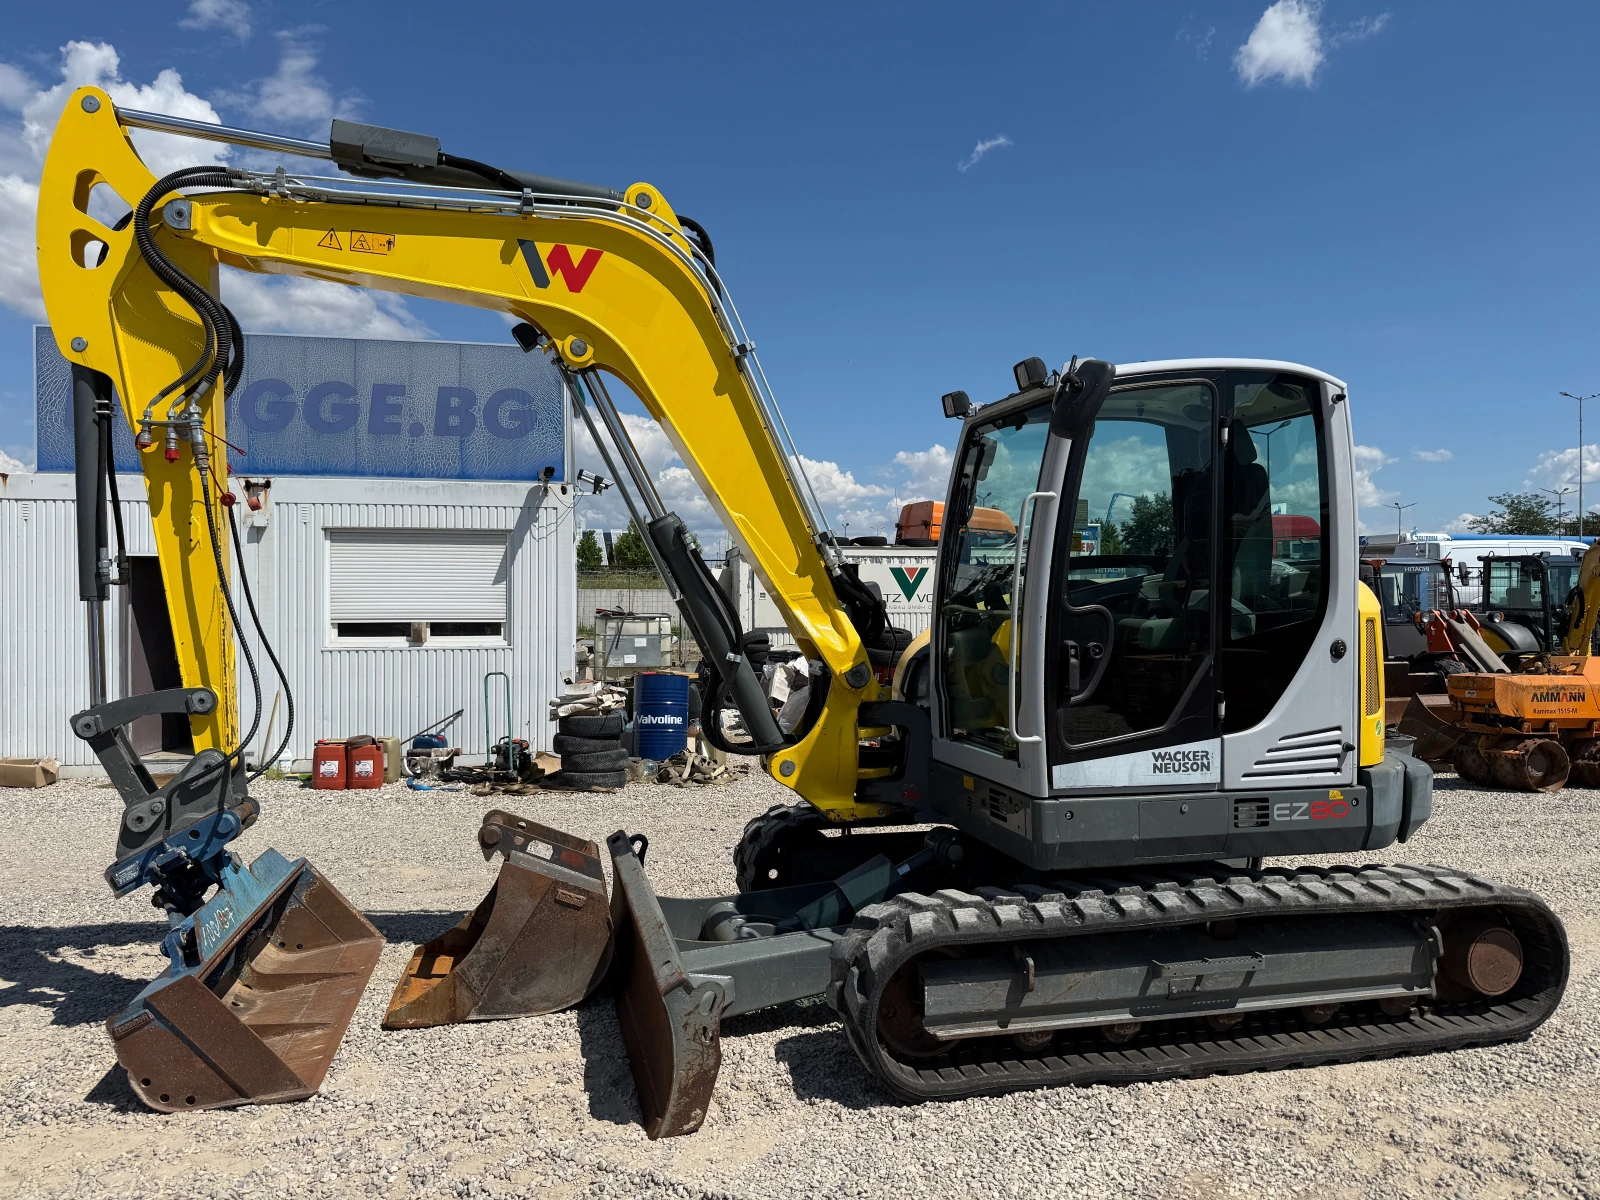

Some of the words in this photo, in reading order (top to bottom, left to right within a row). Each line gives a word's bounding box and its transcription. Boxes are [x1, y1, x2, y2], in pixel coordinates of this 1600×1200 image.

[1530, 691, 1586, 703] AMMANN
[636, 714, 683, 725] Valvoline
[1151, 750, 1211, 763] WACKER
[1152, 761, 1211, 774] NEUSON
[1273, 800, 1349, 821] EZ80
